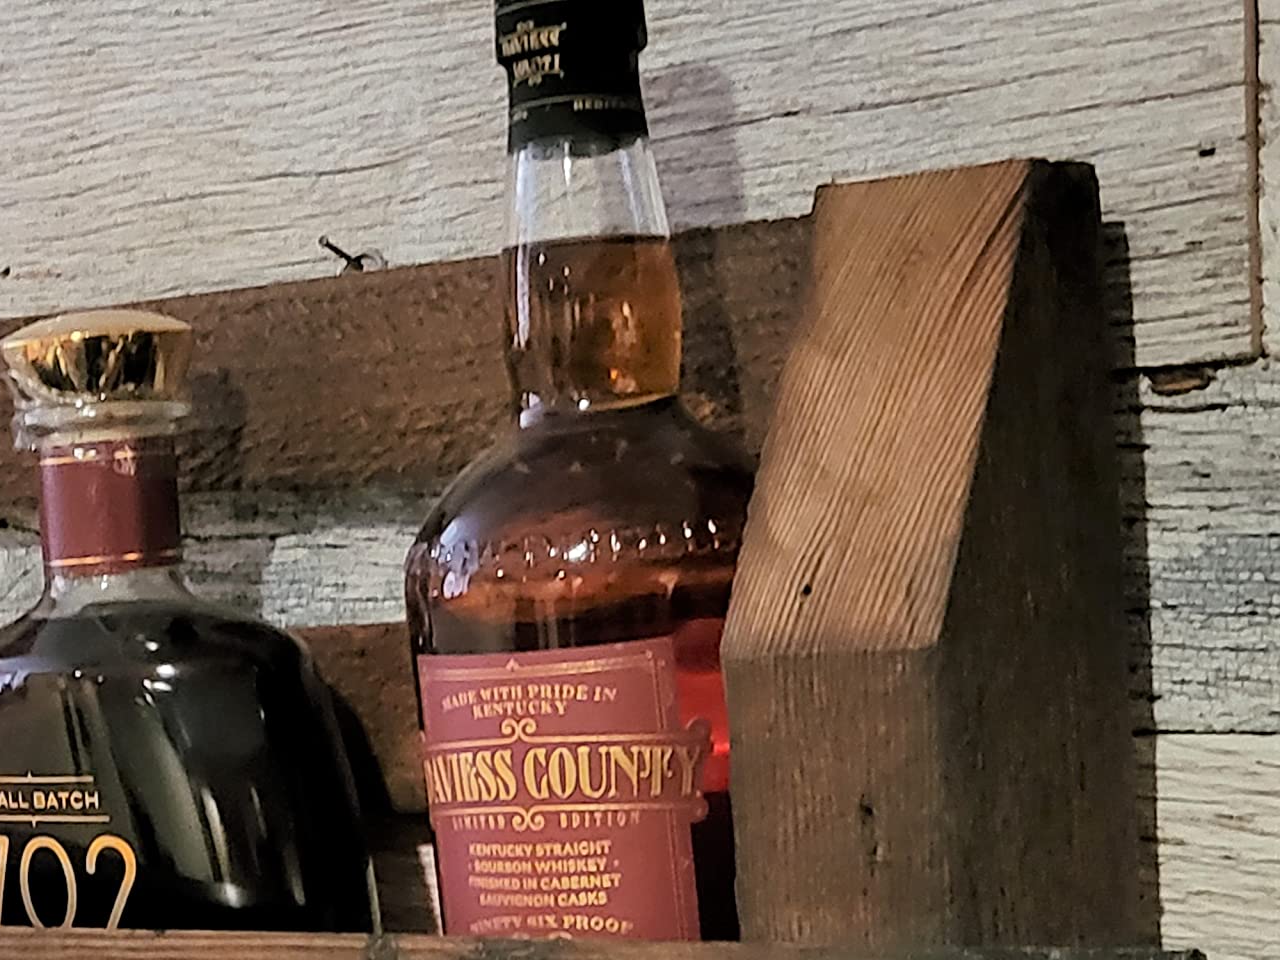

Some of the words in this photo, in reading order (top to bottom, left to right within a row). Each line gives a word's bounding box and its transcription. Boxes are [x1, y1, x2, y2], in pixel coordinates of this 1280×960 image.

[442, 690, 476, 712] MADE
[480, 685, 521, 701] WITH
[527, 684, 588, 700] PRIDE
[593, 686, 617, 702] IN
[473, 700, 567, 720] KENTUCKY
[523, 745, 701, 799] COUNTY
[33, 790, 99, 810] BATCH
[452, 813, 505, 831] LIMITED
[559, 811, 640, 829] EDITION
[469, 842, 532, 858] KENTUCKY
[535, 840, 612, 857] STRAIGHT
[474, 859, 532, 874] BOURBON
[534, 857, 607, 874] WHISKEY
[522, 876, 537, 890] IN
[540, 873, 622, 890] CABERNET
[479, 893, 555, 907] SAUVIGNON
[557, 891, 608, 907] CASKS
[471, 915, 522, 934] NINETY
[527, 914, 558, 929] SIX
[562, 915, 634, 935] PROOF
